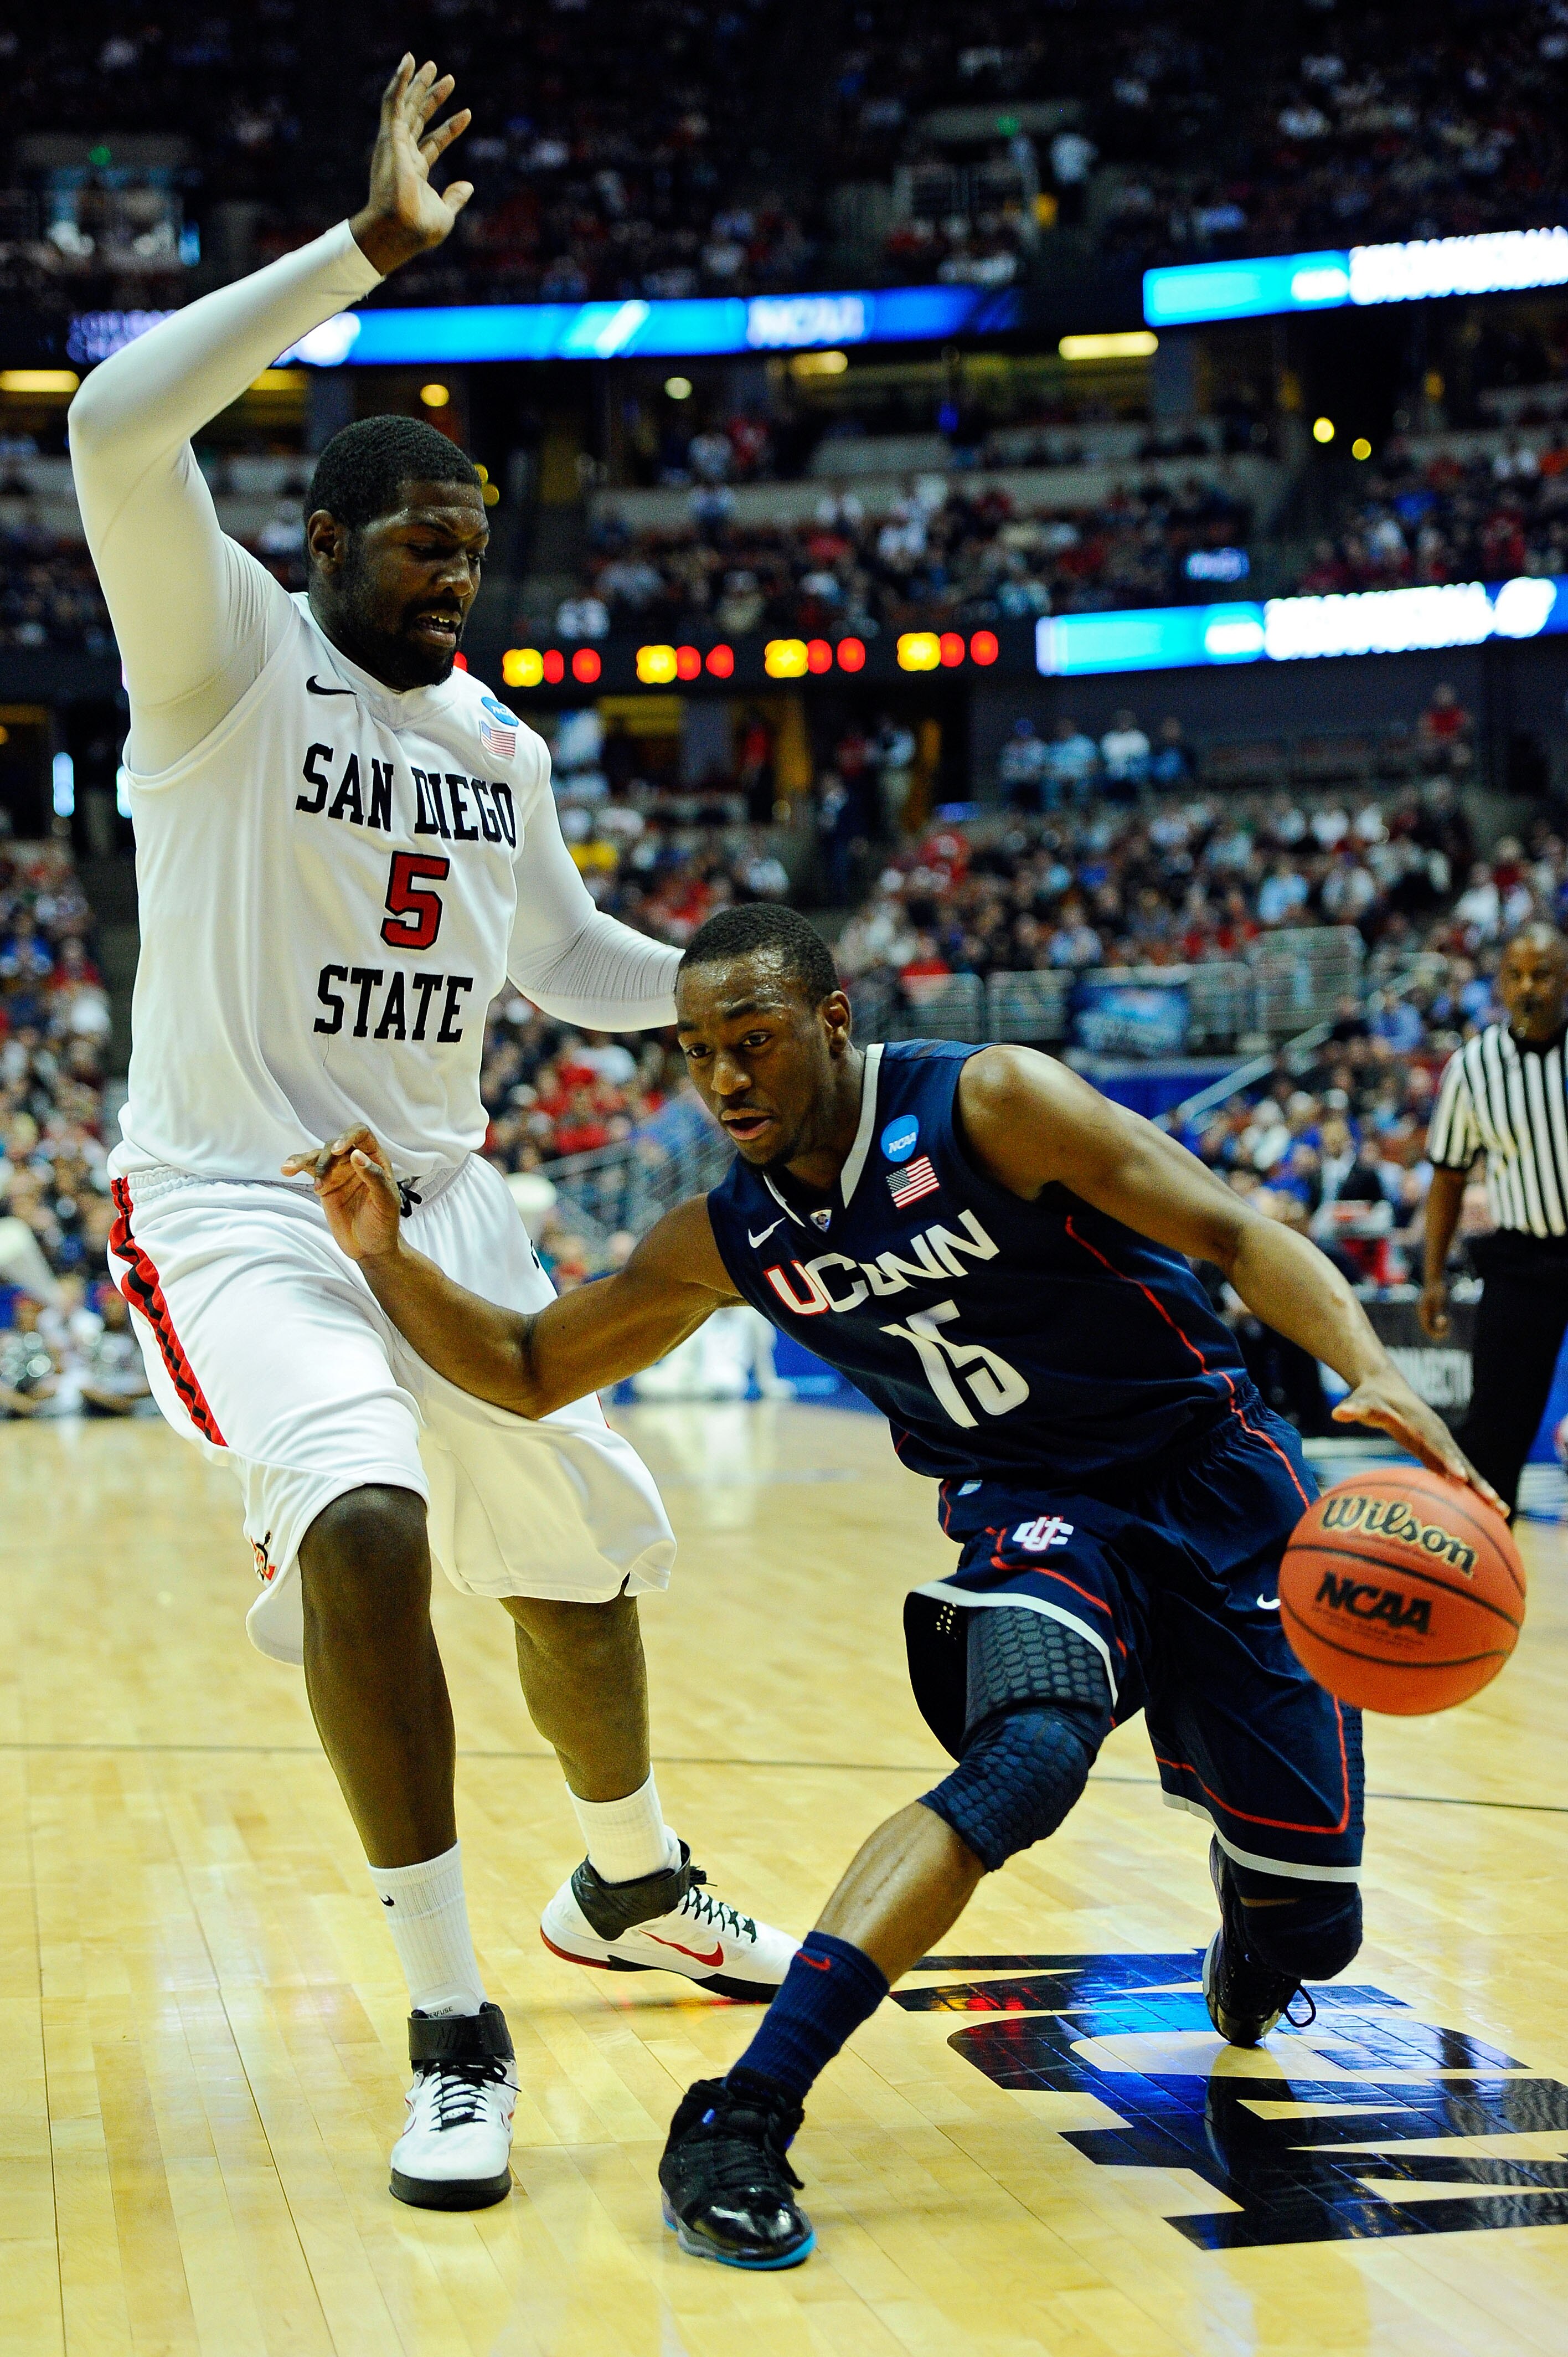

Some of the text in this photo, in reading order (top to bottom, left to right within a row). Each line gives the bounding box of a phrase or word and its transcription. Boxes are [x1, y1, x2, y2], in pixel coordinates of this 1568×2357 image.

[296, 743, 516, 848] SAN DIEGO
[380, 850, 450, 951] 5
[313, 964, 474, 1043] STATE
[888, 1131, 917, 1154] NCAA
[878, 1299, 1030, 1429] 15
[1319, 1495, 1479, 1580] Wilson
[1315, 1570, 1433, 1634] NCAA
